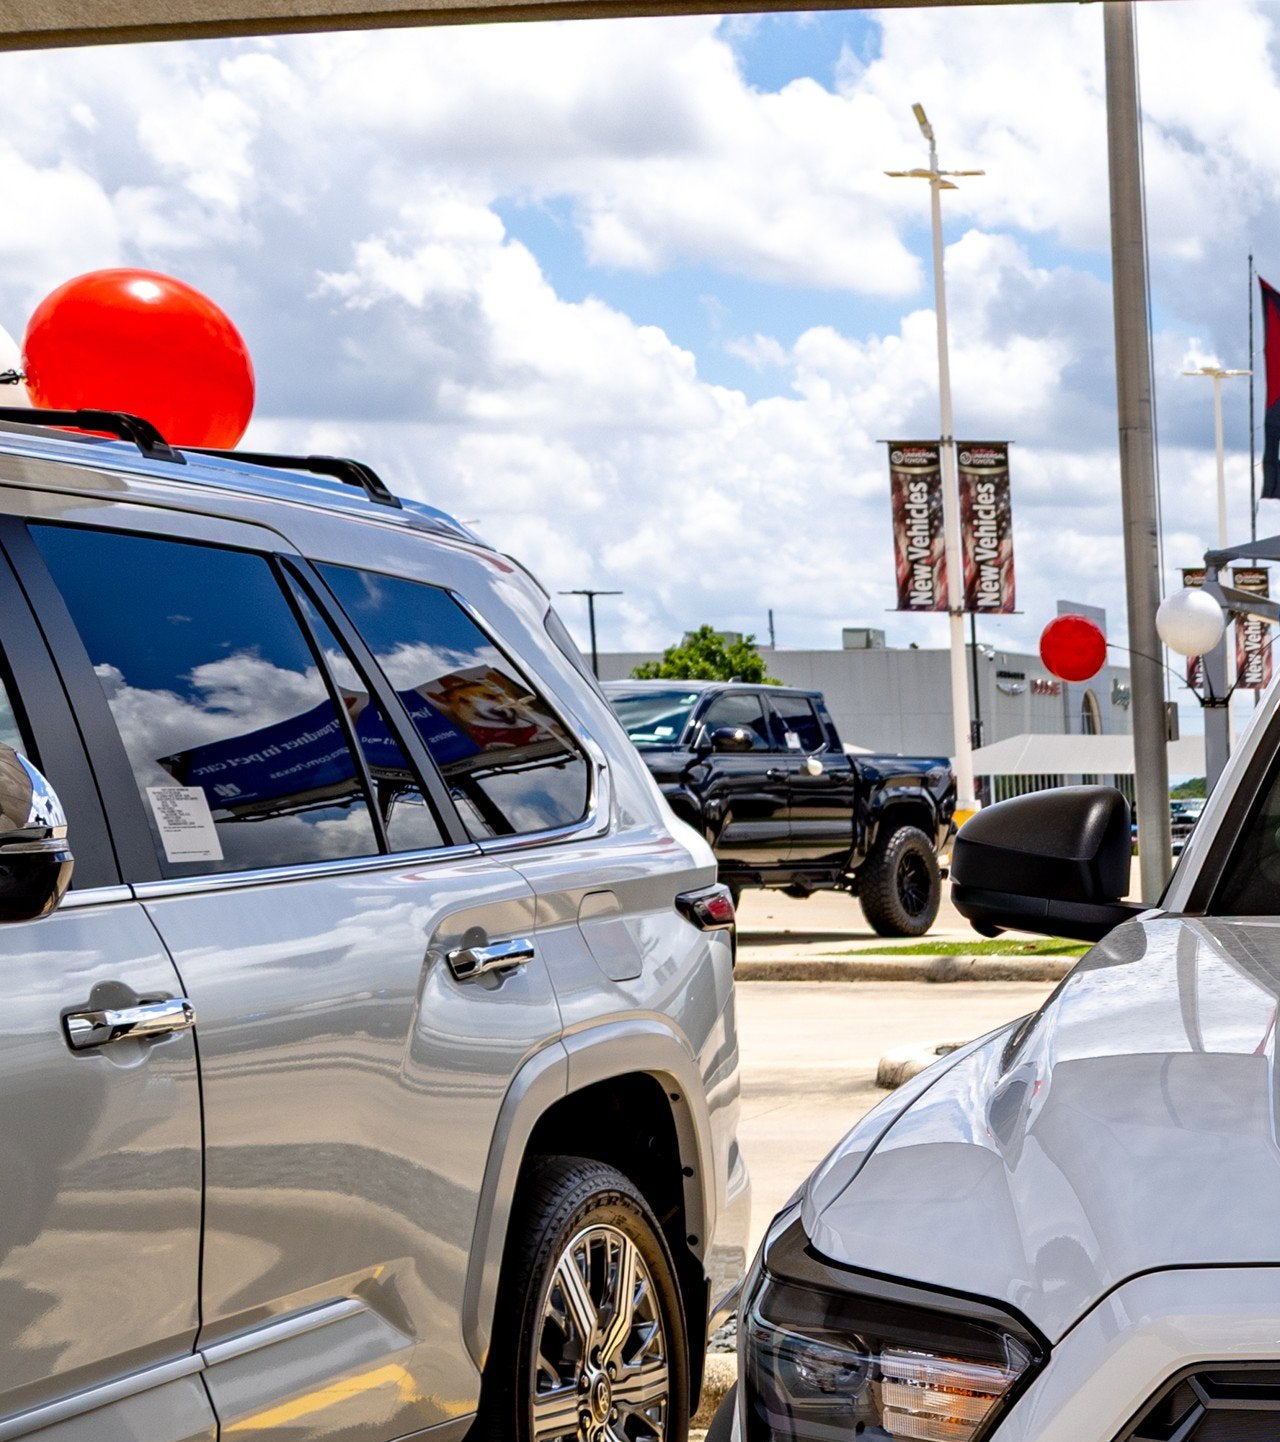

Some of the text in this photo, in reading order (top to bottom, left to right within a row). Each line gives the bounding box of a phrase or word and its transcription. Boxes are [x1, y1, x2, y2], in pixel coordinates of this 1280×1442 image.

[904, 481, 930, 561] Vehicles
[972, 482, 998, 562] Vehicles
[910, 563, 933, 605] New
[977, 564, 1001, 607] New
